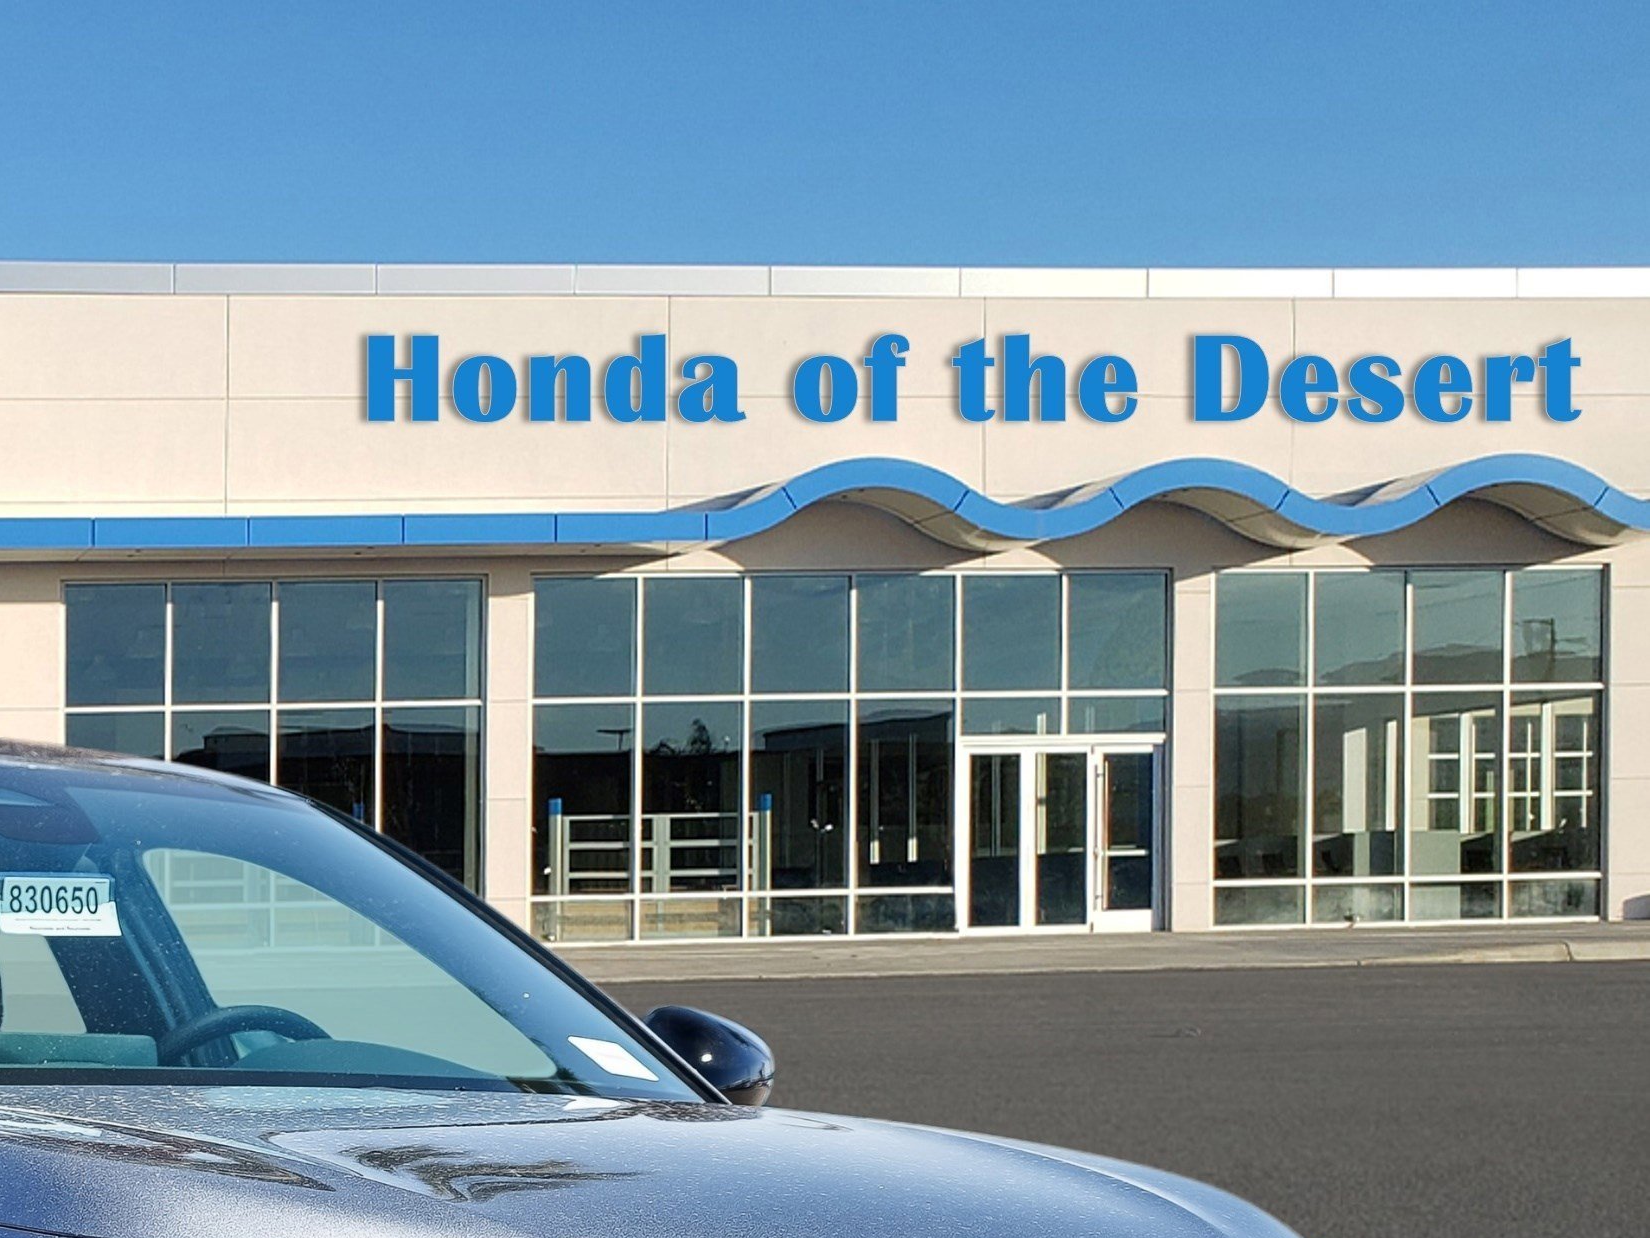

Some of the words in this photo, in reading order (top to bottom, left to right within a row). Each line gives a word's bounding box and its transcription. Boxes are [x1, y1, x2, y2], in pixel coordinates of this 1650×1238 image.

[366, 333, 747, 423] Honda
[793, 333, 910, 423] of
[951, 333, 1139, 423] the
[1192, 334, 1583, 423] Desert
[9, 884, 99, 915] 830650
